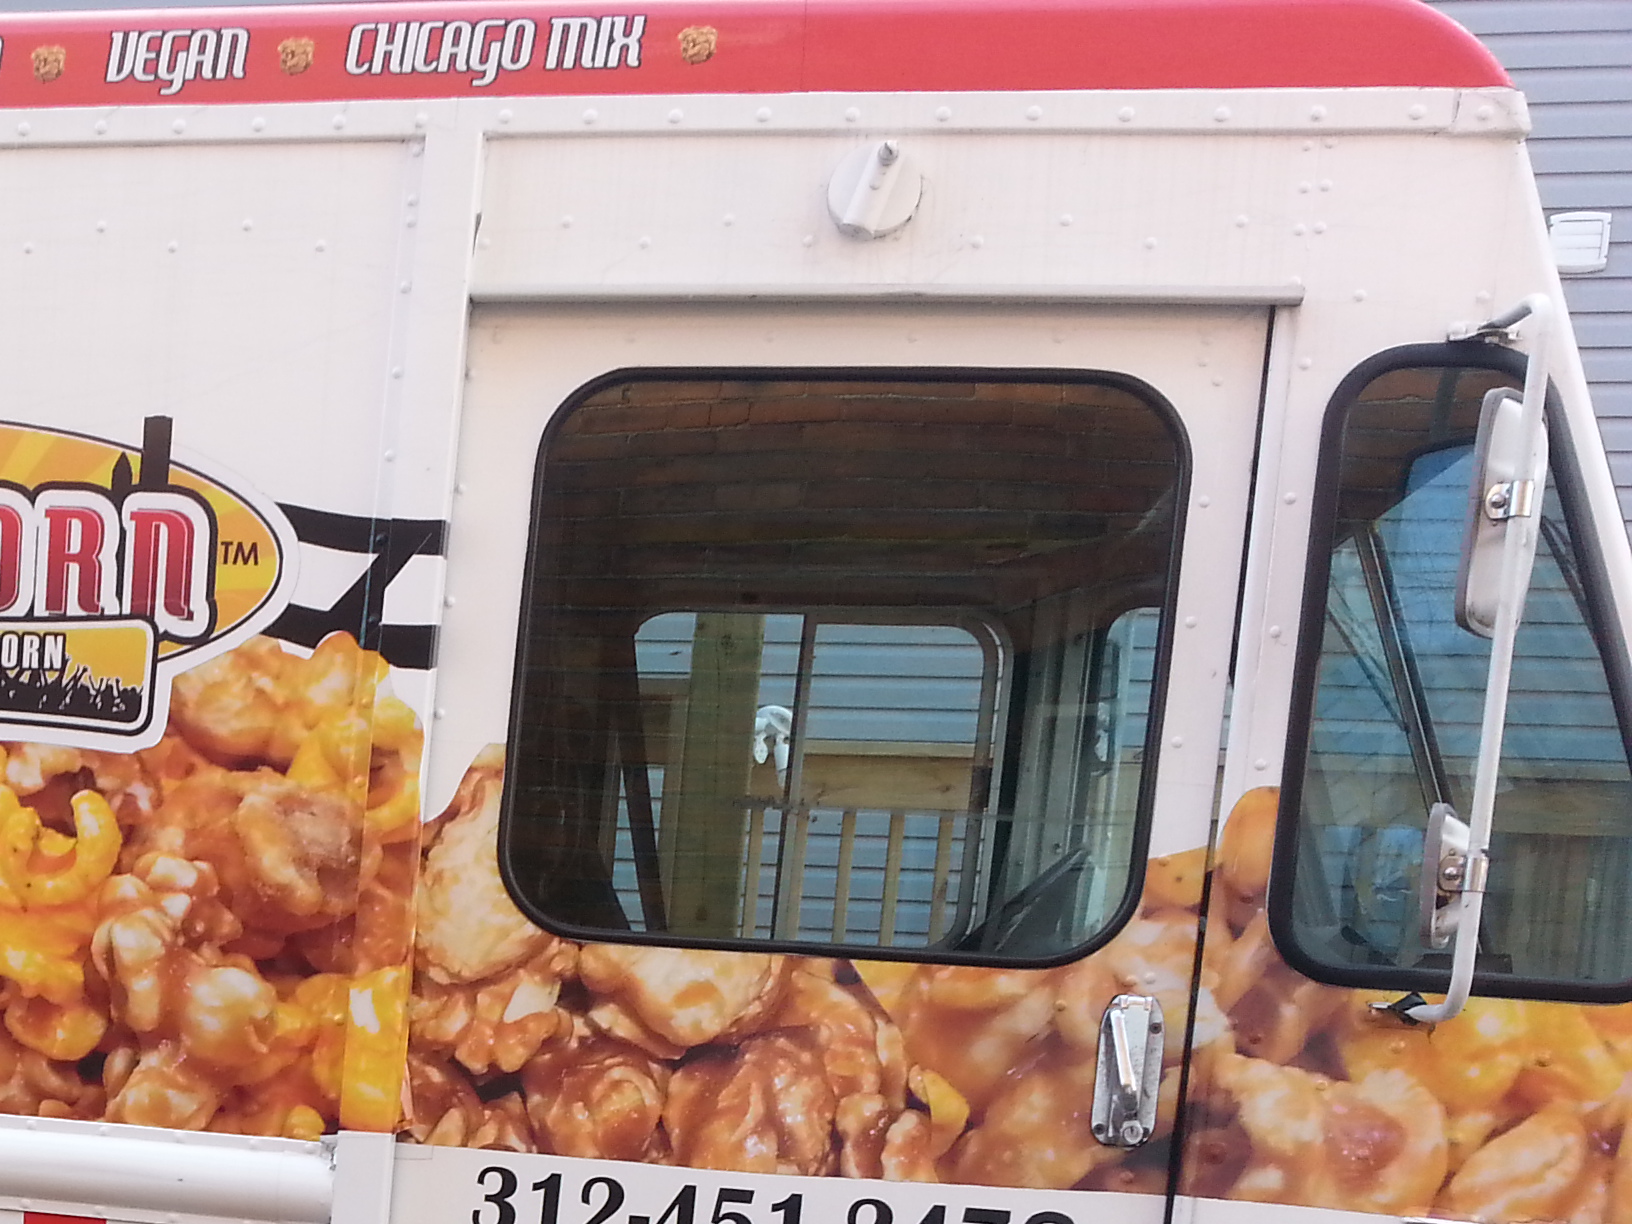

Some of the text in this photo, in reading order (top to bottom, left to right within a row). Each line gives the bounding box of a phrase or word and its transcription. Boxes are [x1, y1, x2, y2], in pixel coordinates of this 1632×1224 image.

[105, 27, 250, 95] VEGAN
[345, 18, 537, 87] CHICAGO
[544, 15, 647, 70] MIX
[219, 540, 260, 567] TM
